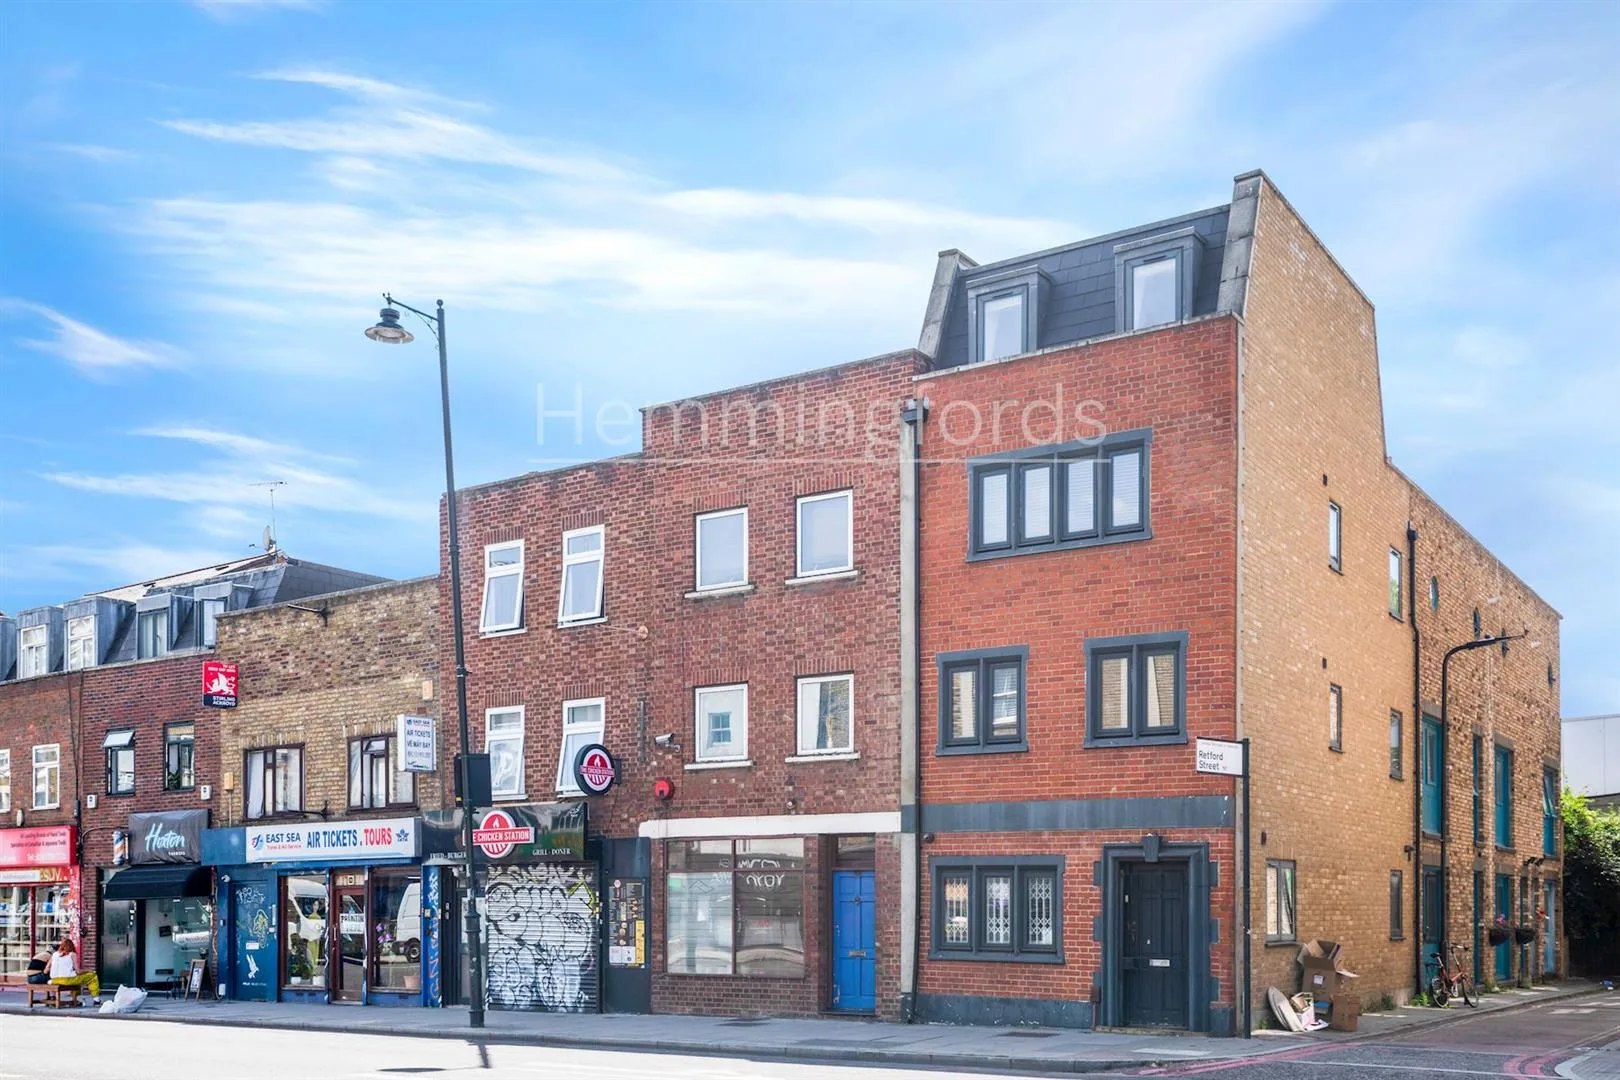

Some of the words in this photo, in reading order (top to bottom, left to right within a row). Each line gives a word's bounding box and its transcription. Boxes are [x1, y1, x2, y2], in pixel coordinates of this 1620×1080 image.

[414, 730, 431, 738] TICKETS
[1198, 750, 1223, 760] Retford
[1198, 760, 1220, 770] Street
[144, 822, 185, 852] Hoxton
[266, 833, 284, 843] EAST
[286, 832, 301, 842] SEA
[307, 831, 321, 848] AIR
[322, 829, 357, 848] TICKETS
[364, 828, 392, 846] TOURS
[478, 831, 504, 842] CHICKEN
[504, 830, 530, 841] STATION
[532, 848, 548, 856] GRILL
